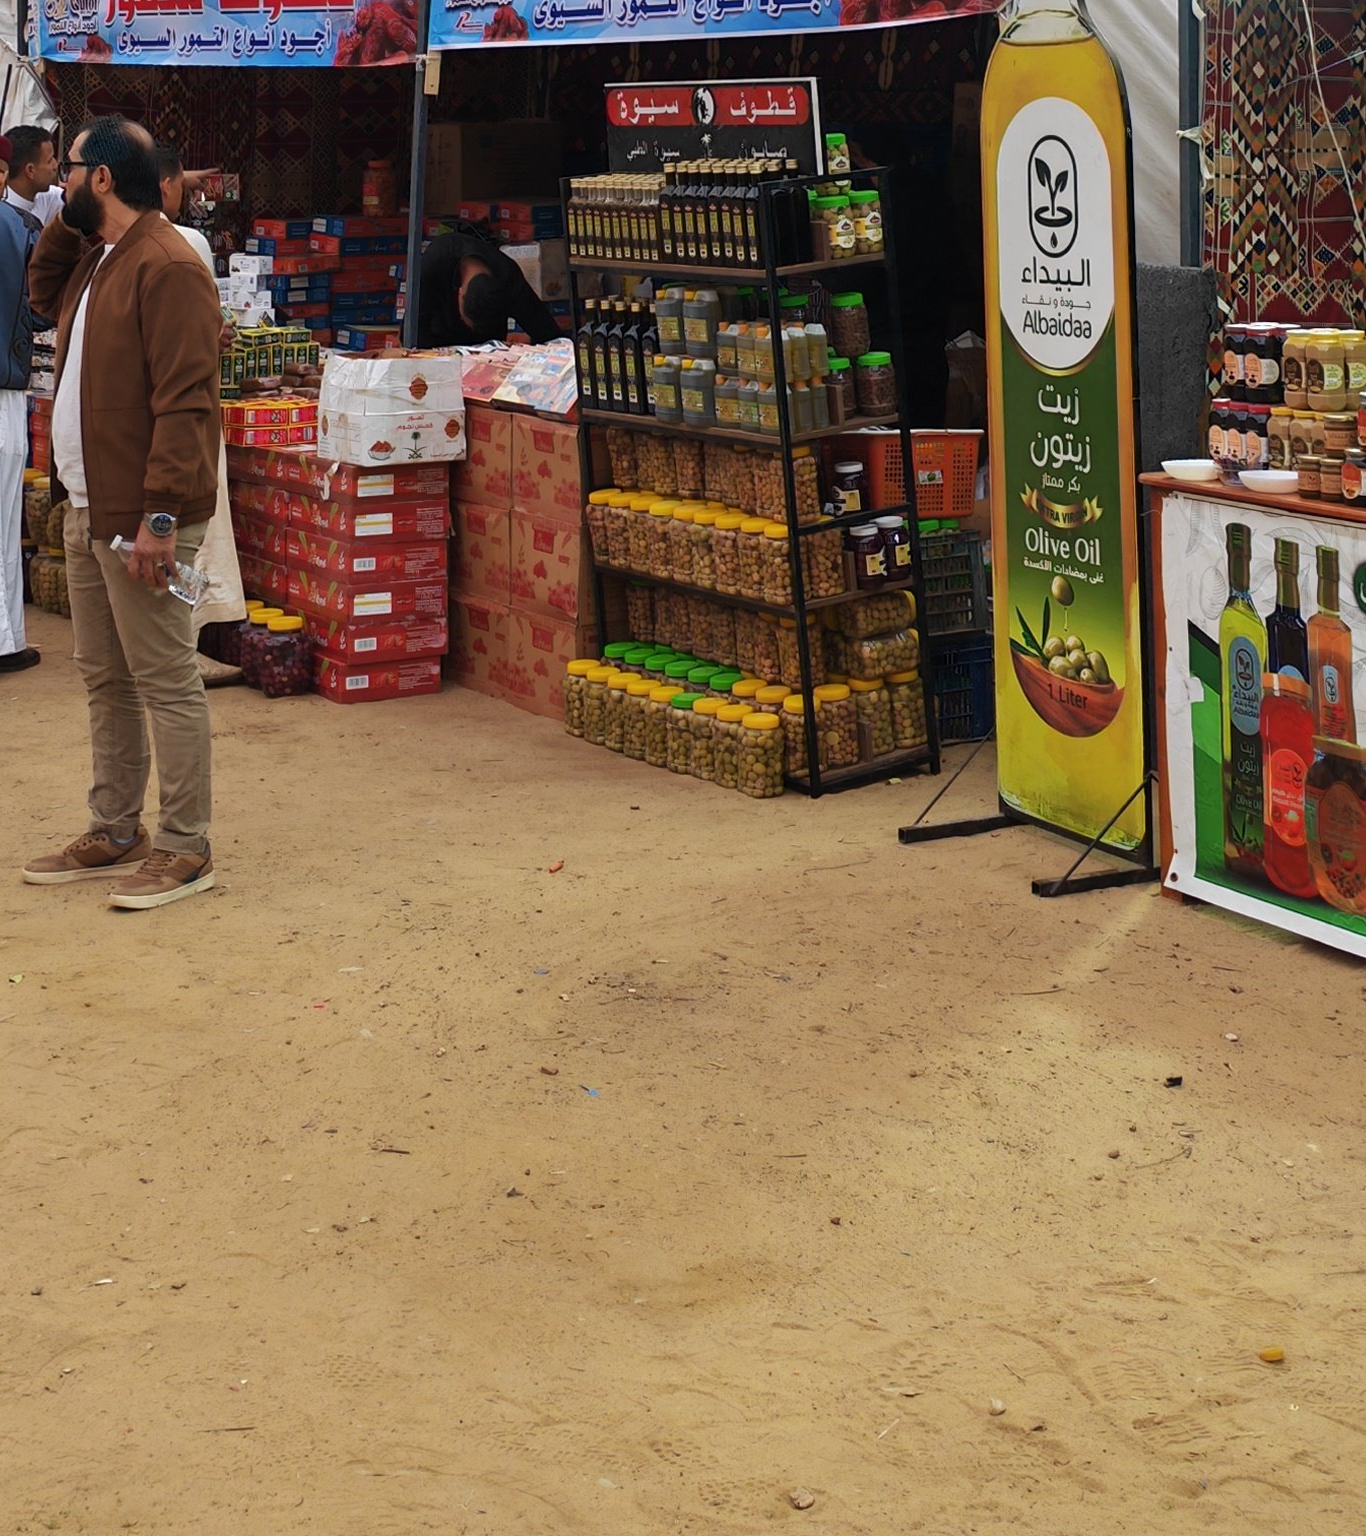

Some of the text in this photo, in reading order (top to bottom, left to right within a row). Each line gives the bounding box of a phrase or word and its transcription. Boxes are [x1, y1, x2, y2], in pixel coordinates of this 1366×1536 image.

[178, 26, 228, 55] التمور
[618, 86, 797, 124] قطوف سيوة
[1020, 257, 1091, 292] البيداء
[1060, 295, 1092, 309] جودة
[1022, 310, 1092, 339] Albaidaa
[1037, 383, 1080, 424] زيت
[1030, 431, 1091, 474] زيتون
[1025, 527, 1101, 566] Olive Oil
[1058, 686, 1088, 711] Liter
